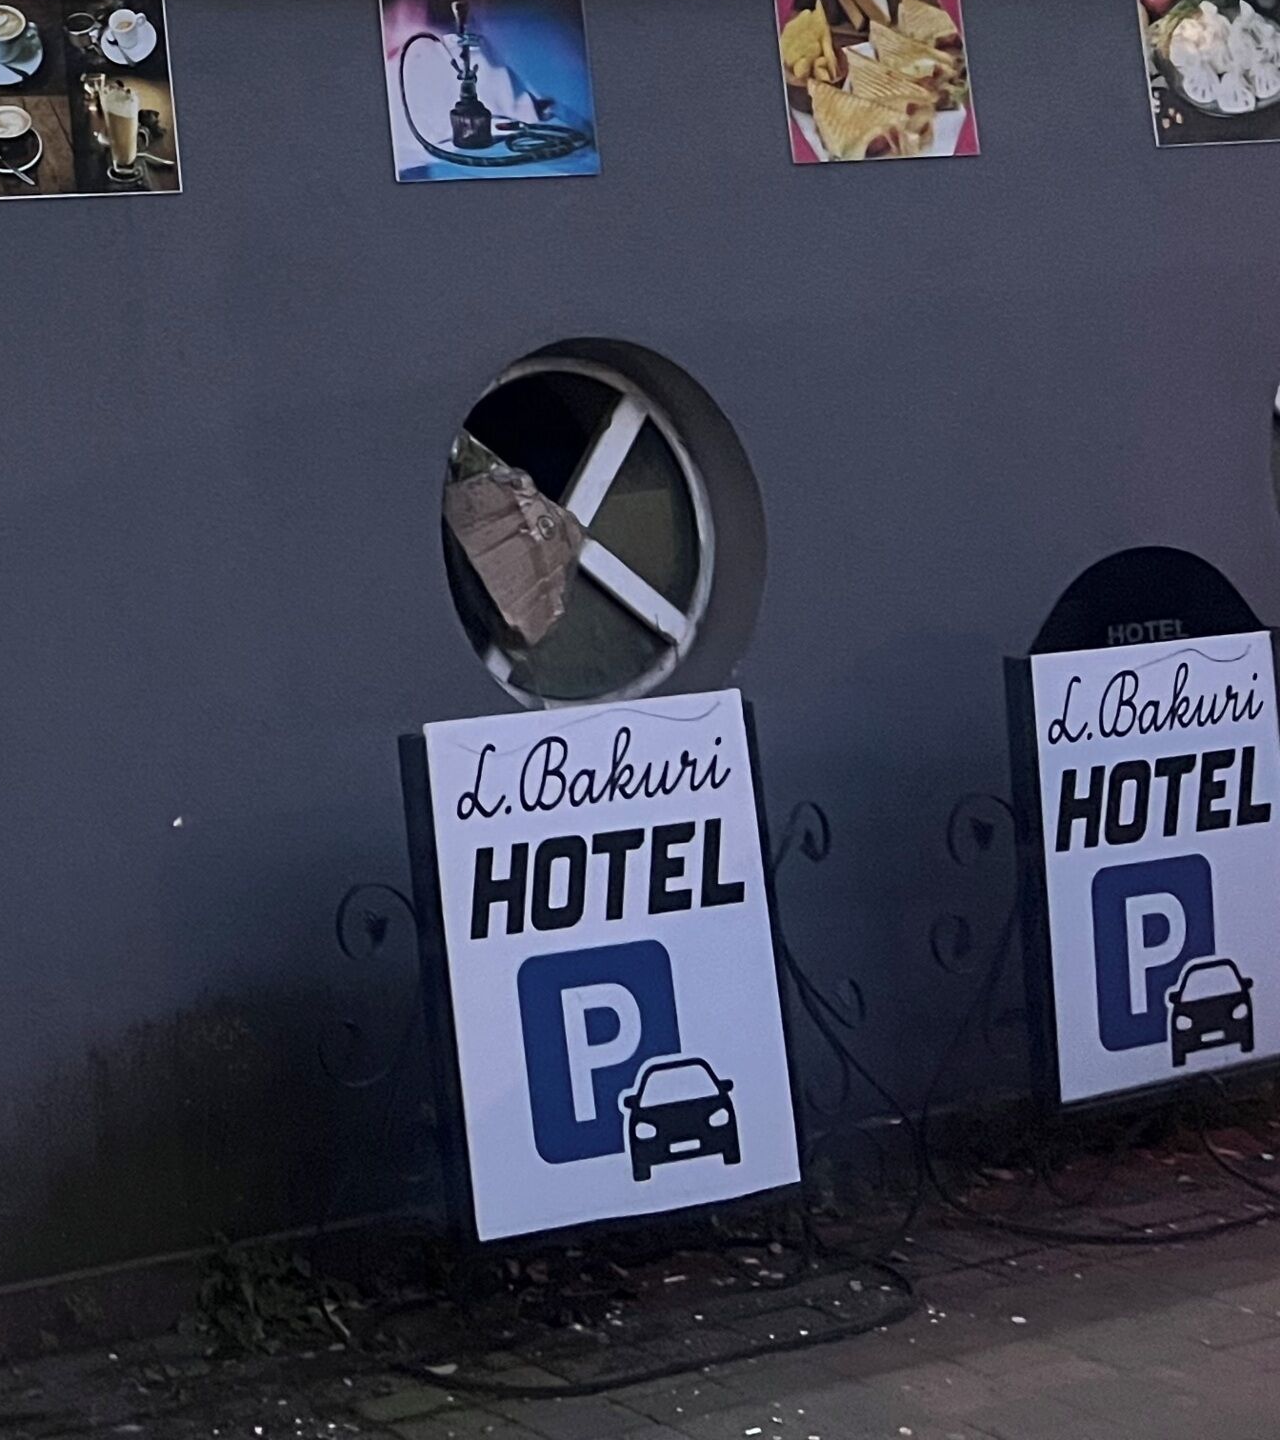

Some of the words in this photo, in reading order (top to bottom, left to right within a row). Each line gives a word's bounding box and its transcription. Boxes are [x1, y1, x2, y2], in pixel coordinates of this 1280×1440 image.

[1107, 619, 1189, 645] HOTEL
[1056, 746, 1272, 852] HOTEL
[470, 818, 746, 940] HOTEL
[1123, 891, 1188, 1016] P
[560, 982, 643, 1123] P
